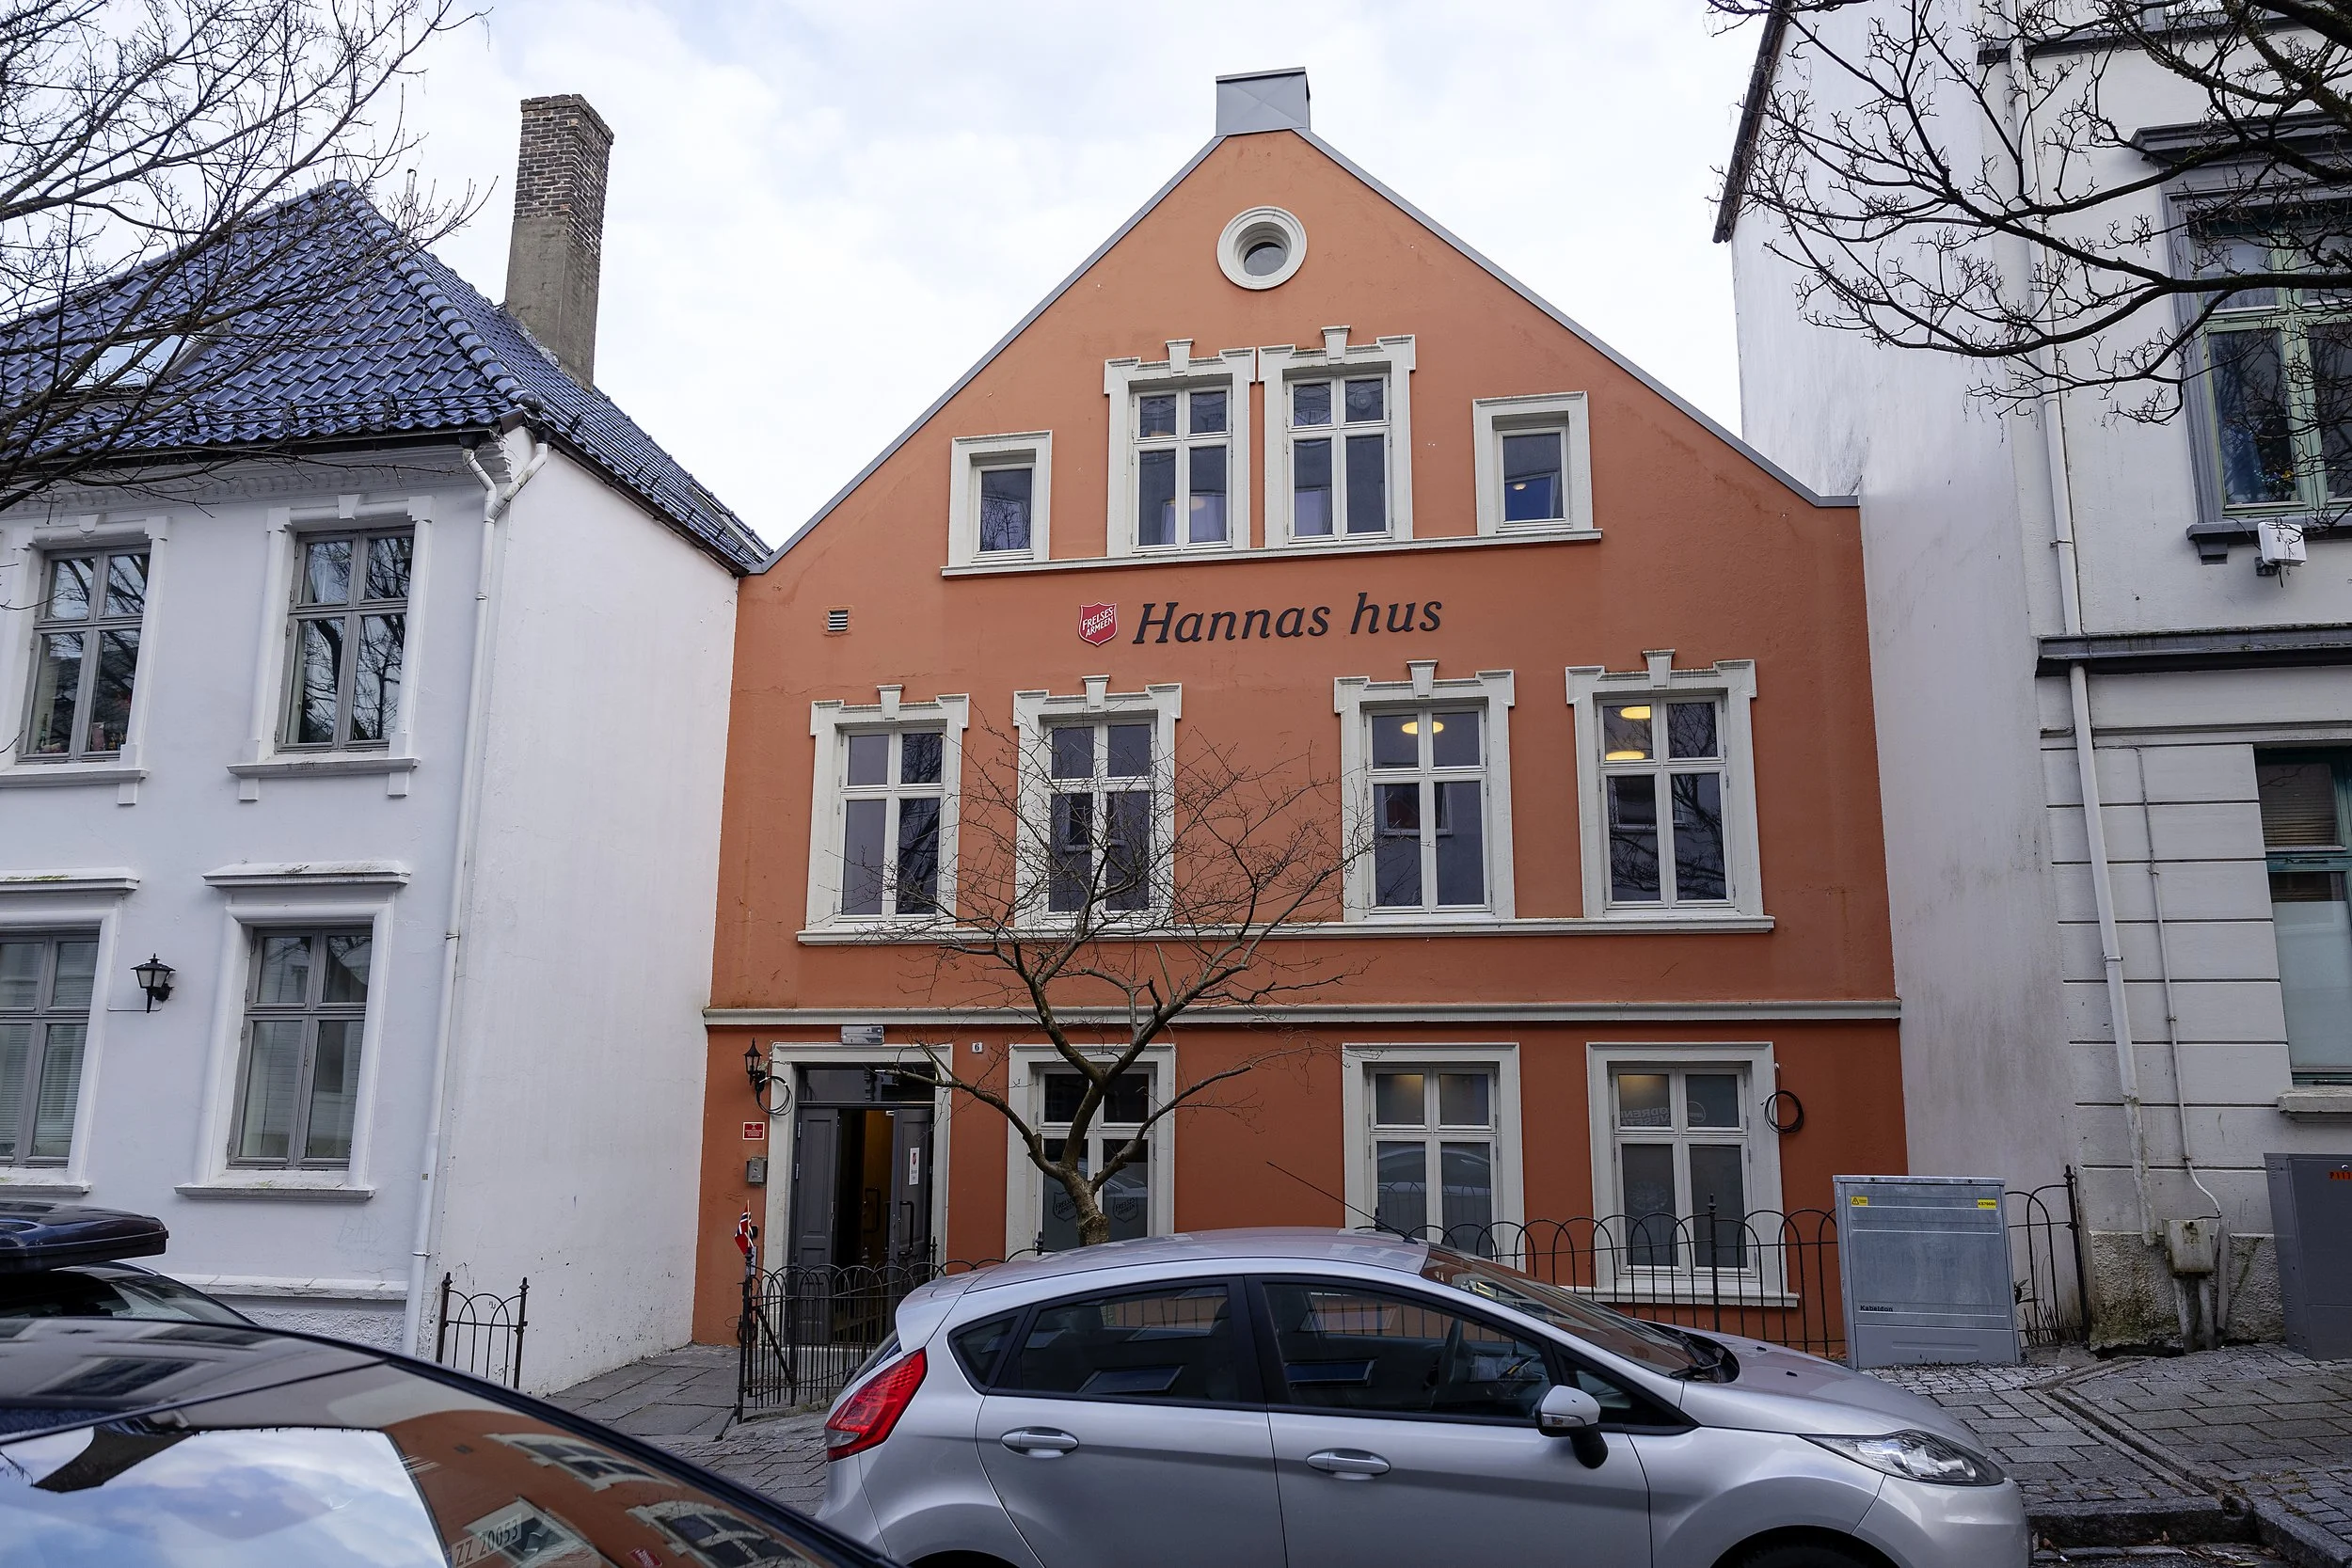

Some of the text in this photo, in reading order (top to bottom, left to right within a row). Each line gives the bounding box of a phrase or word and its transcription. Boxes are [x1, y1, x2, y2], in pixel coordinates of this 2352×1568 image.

[1082, 606, 1114, 631] FRELSES
[1085, 615, 1114, 638] ARMEEN
[1132, 592, 1442, 644] Hannas hus
[455, 1518, 518, 1567] ZZ 20053
